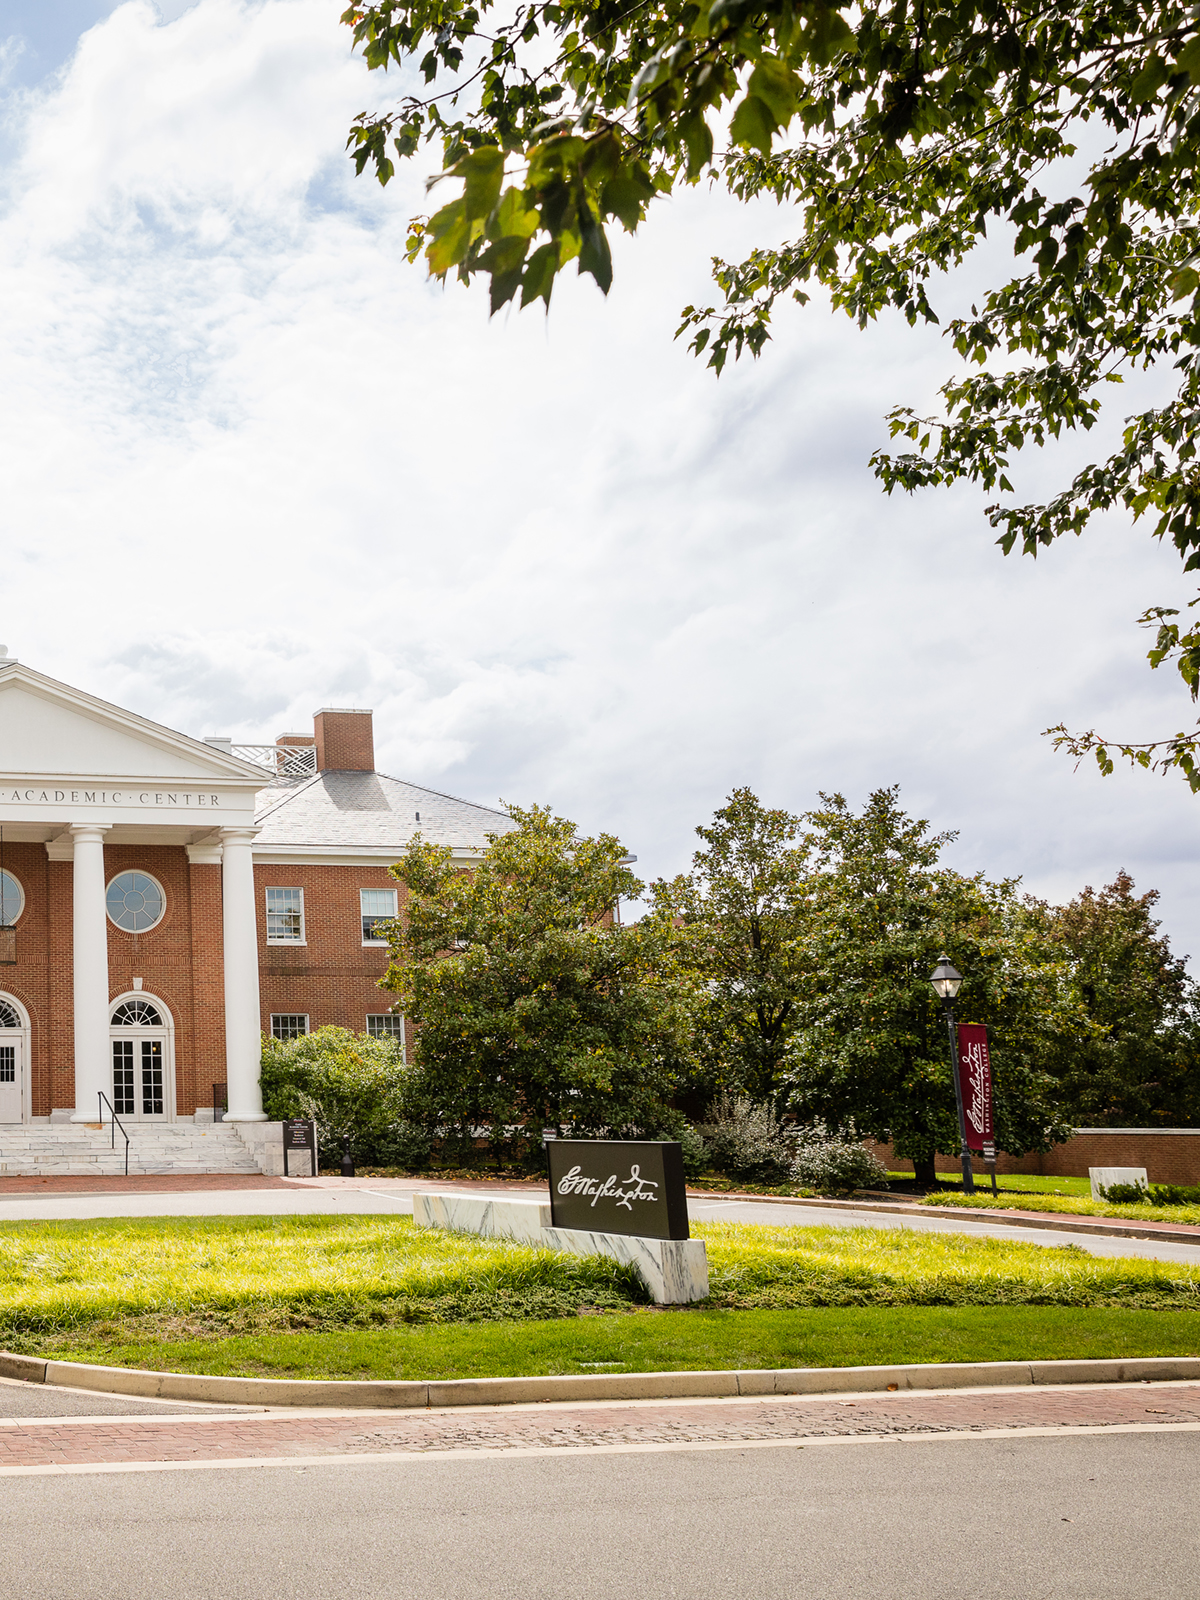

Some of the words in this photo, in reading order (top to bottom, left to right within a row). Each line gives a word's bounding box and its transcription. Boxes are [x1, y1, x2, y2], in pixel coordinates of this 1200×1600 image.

[11, 790, 122, 803] ACADEMIC
[139, 793, 220, 806] CENTER
[981, 1043, 989, 1078] COLLEGE
